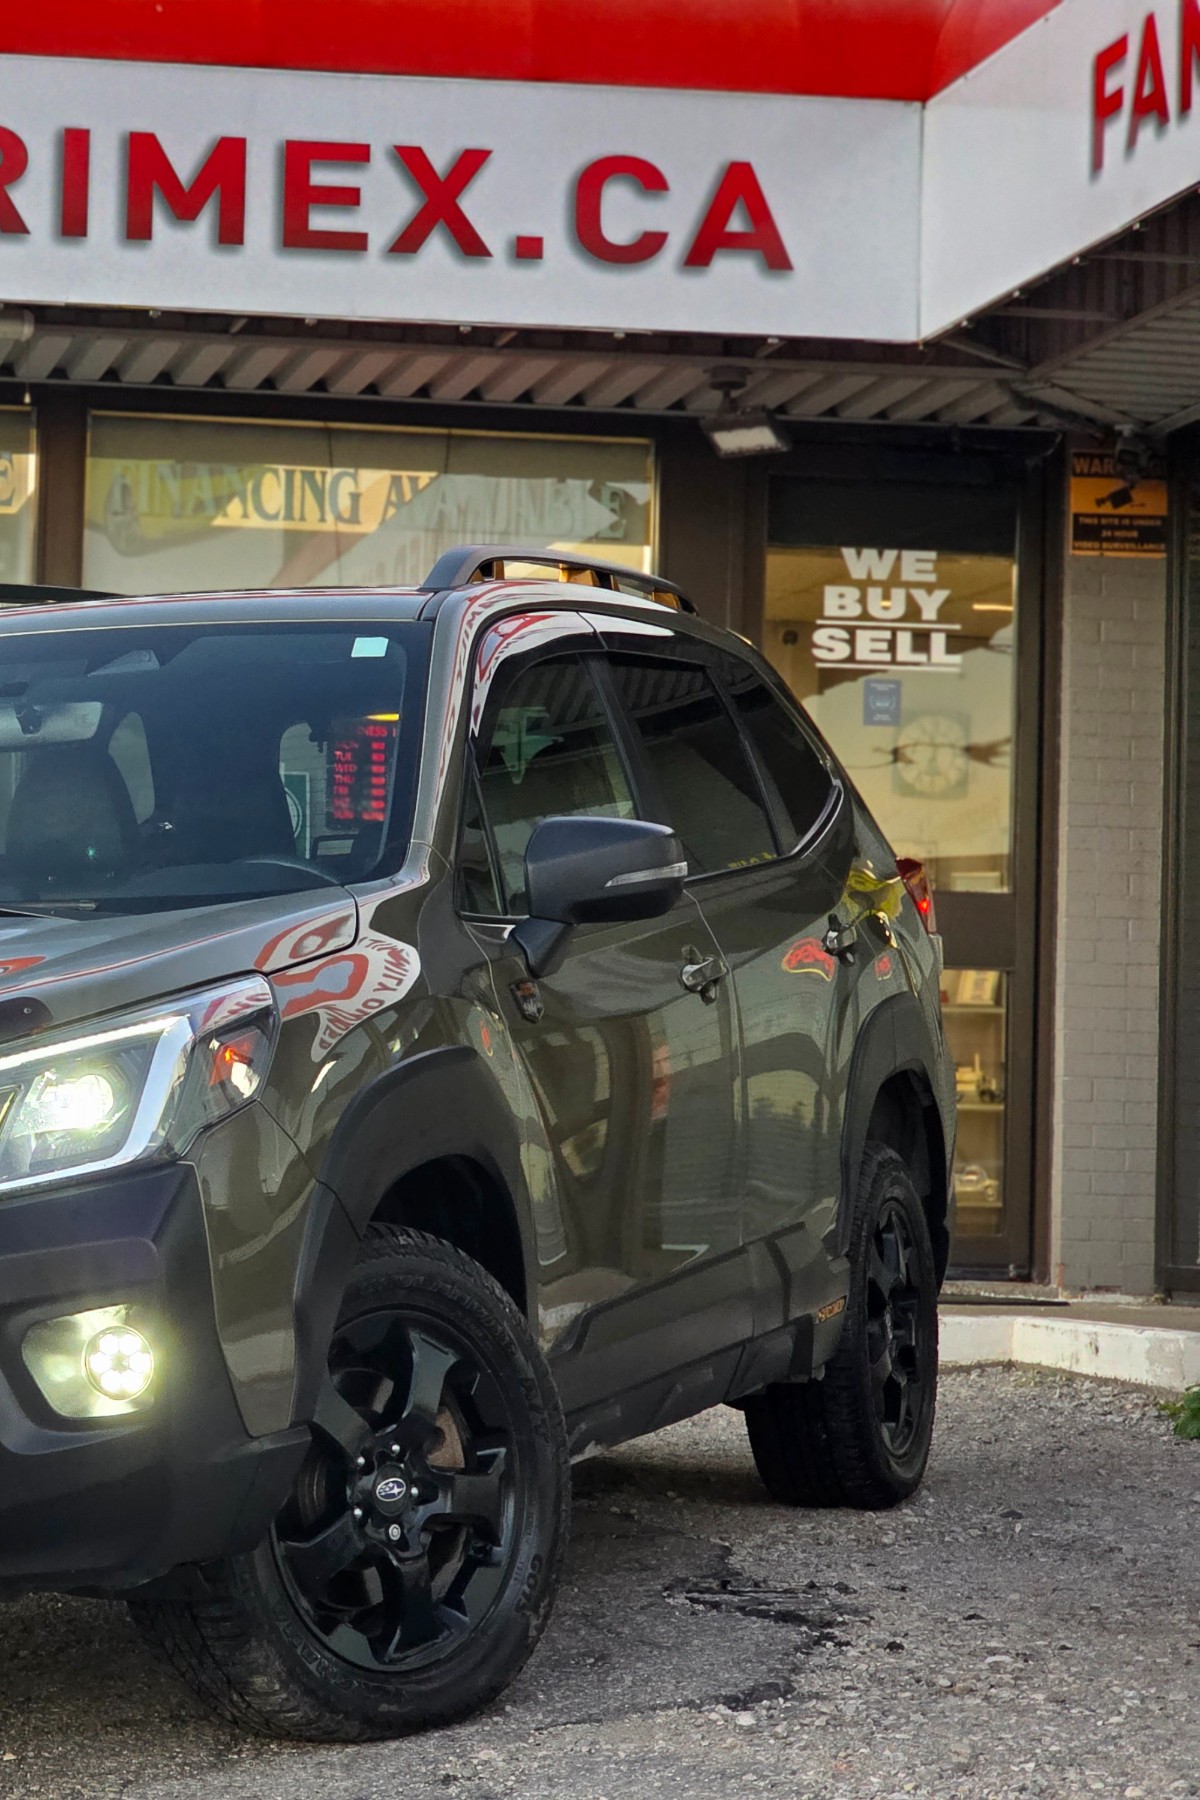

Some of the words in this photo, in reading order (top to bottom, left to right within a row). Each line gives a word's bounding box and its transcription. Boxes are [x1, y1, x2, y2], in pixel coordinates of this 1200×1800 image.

[112, 464, 361, 525] FINANCING
[1074, 541, 1100, 549] VIDEO
[841, 547, 937, 582] WE
[824, 586, 950, 620] BUY
[812, 628, 962, 663] SELL
